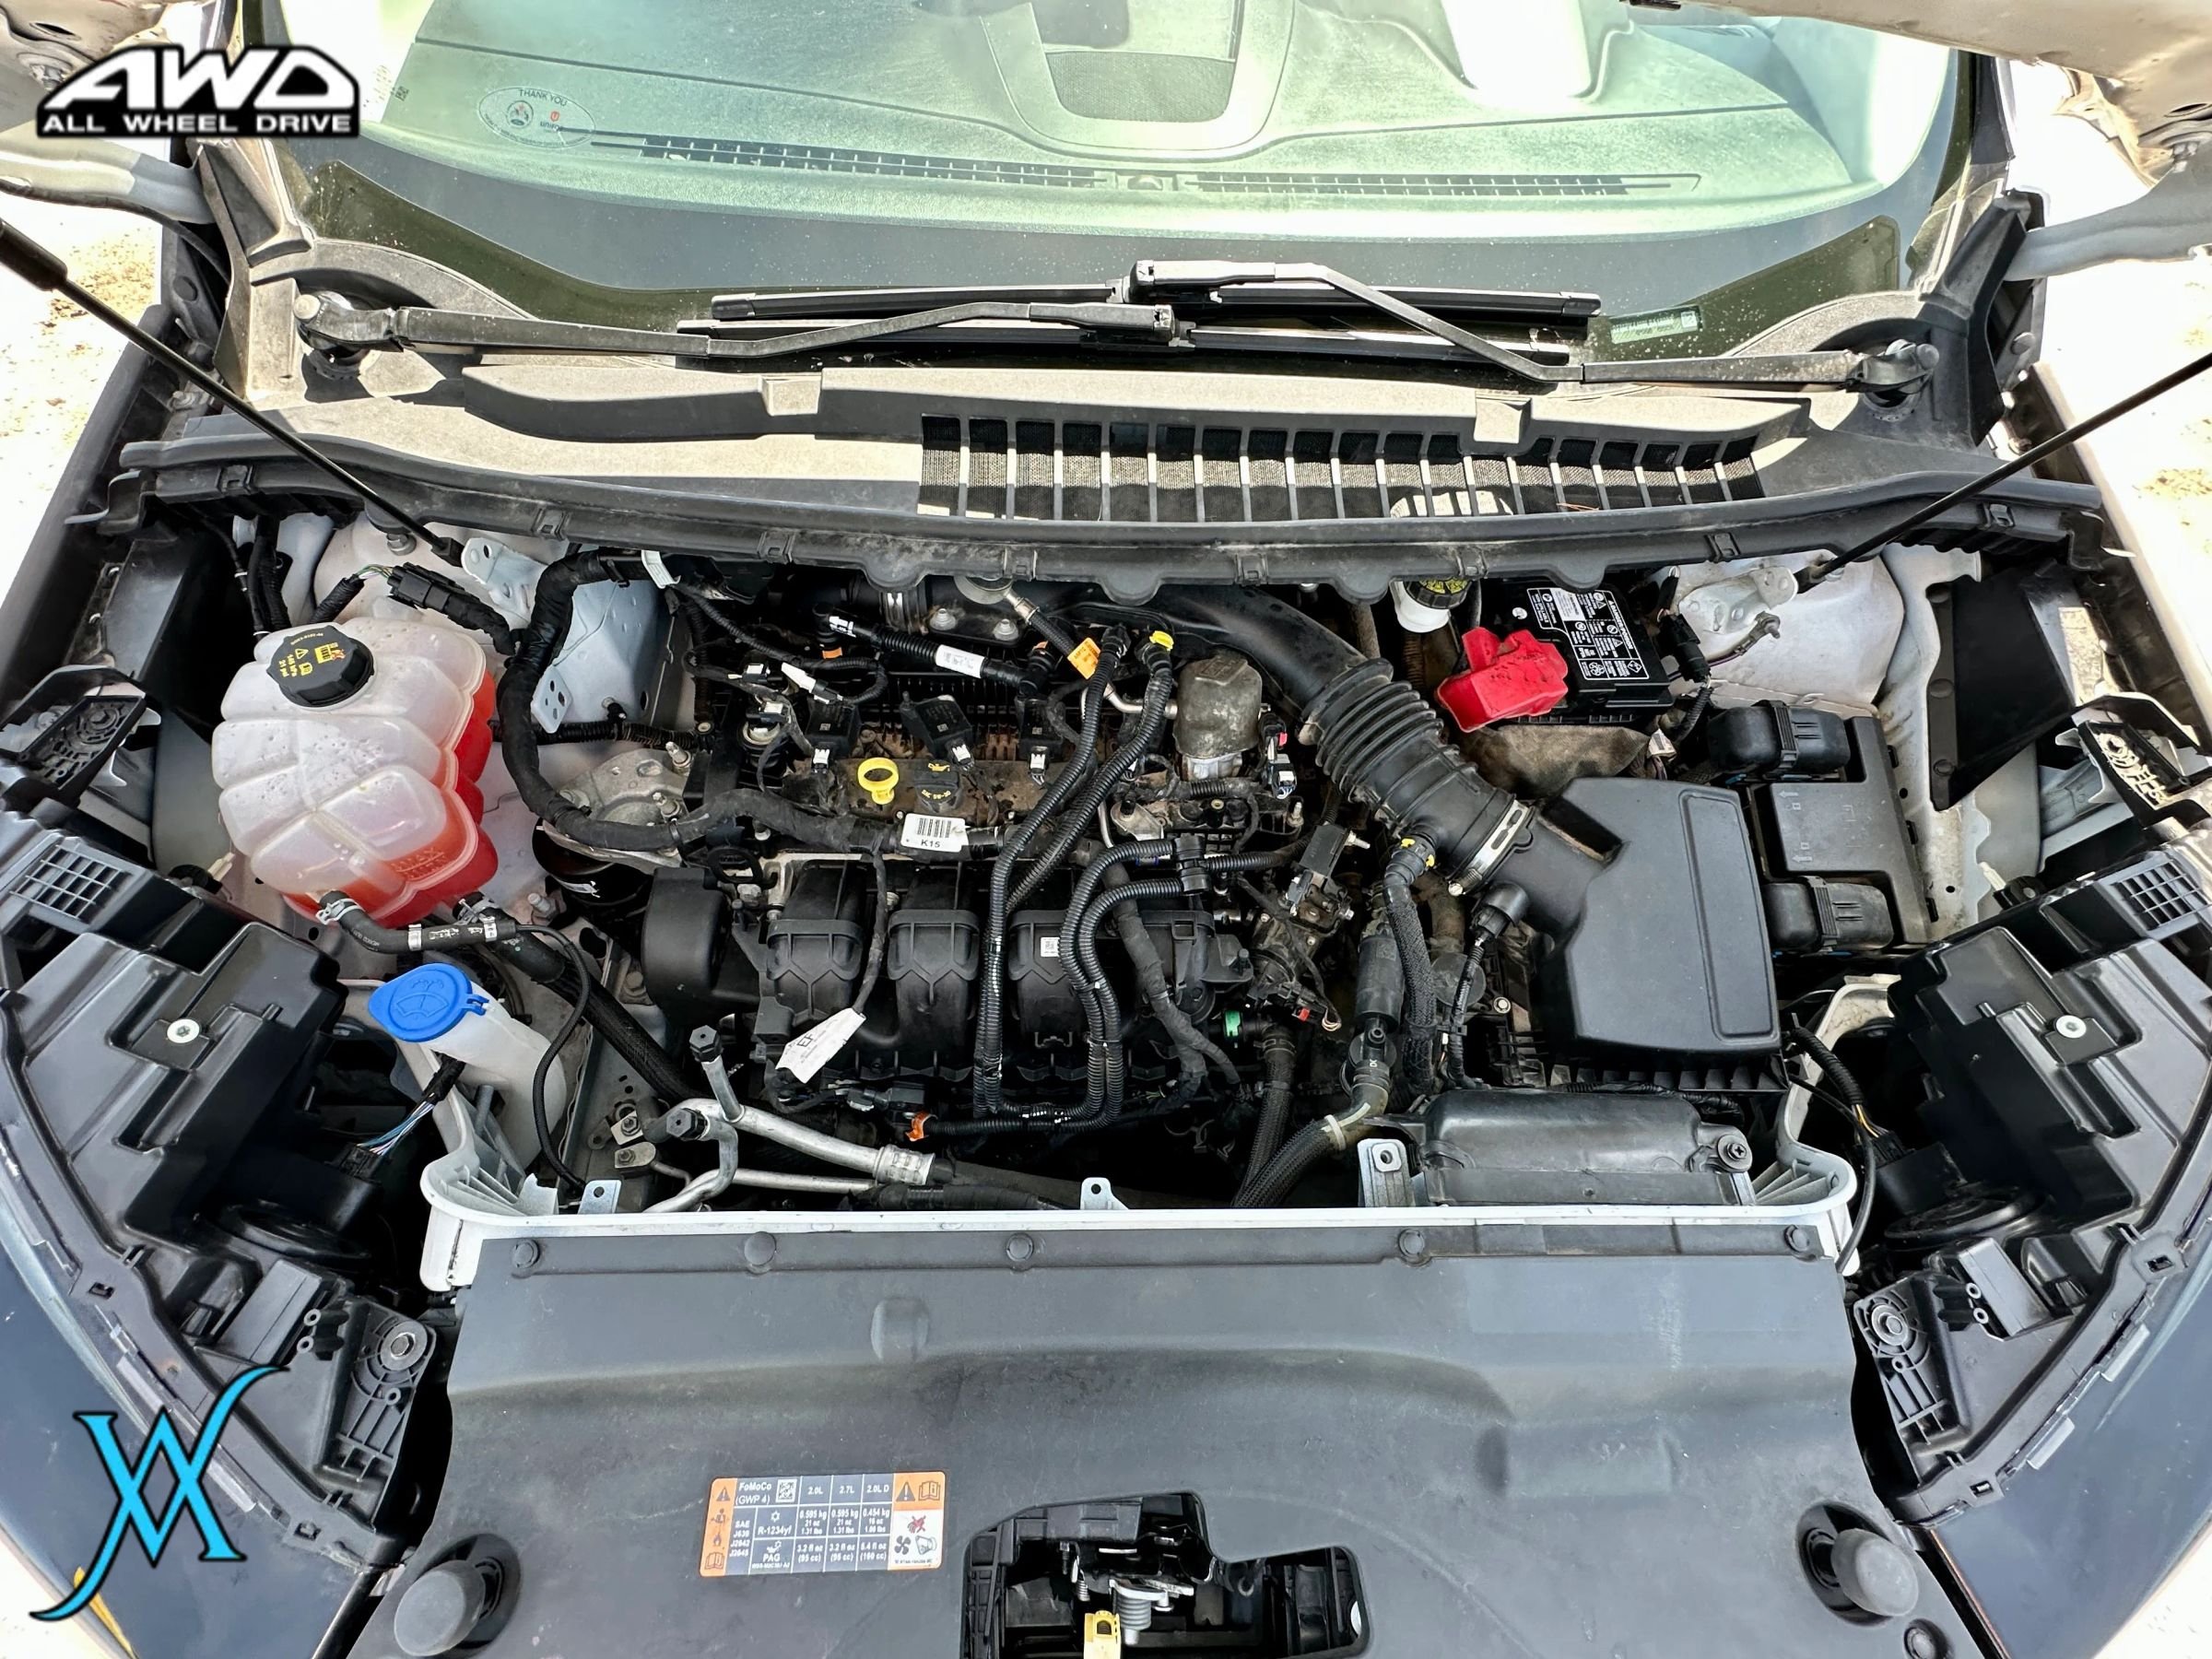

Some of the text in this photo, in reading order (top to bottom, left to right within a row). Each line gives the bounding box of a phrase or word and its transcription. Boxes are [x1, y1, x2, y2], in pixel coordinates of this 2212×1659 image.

[519, 88, 568, 107] THANK YOU
[921, 839, 941, 848] K15
[738, 1481, 772, 1491] FoMoCo
[807, 1486, 824, 1495] 2.0L
[839, 1485, 855, 1494] 2.7L
[866, 1484, 889, 1493] 2.0L D
[735, 1495, 771, 1505] (GWP 4)
[818, 1509, 828, 1520] kg
[850, 1508, 859, 1520] kg
[881, 1508, 890, 1519] kg
[735, 1520, 750, 1528] SAE
[758, 1525, 792, 1536] R-1234yf
[762, 1553, 781, 1562] PAG
